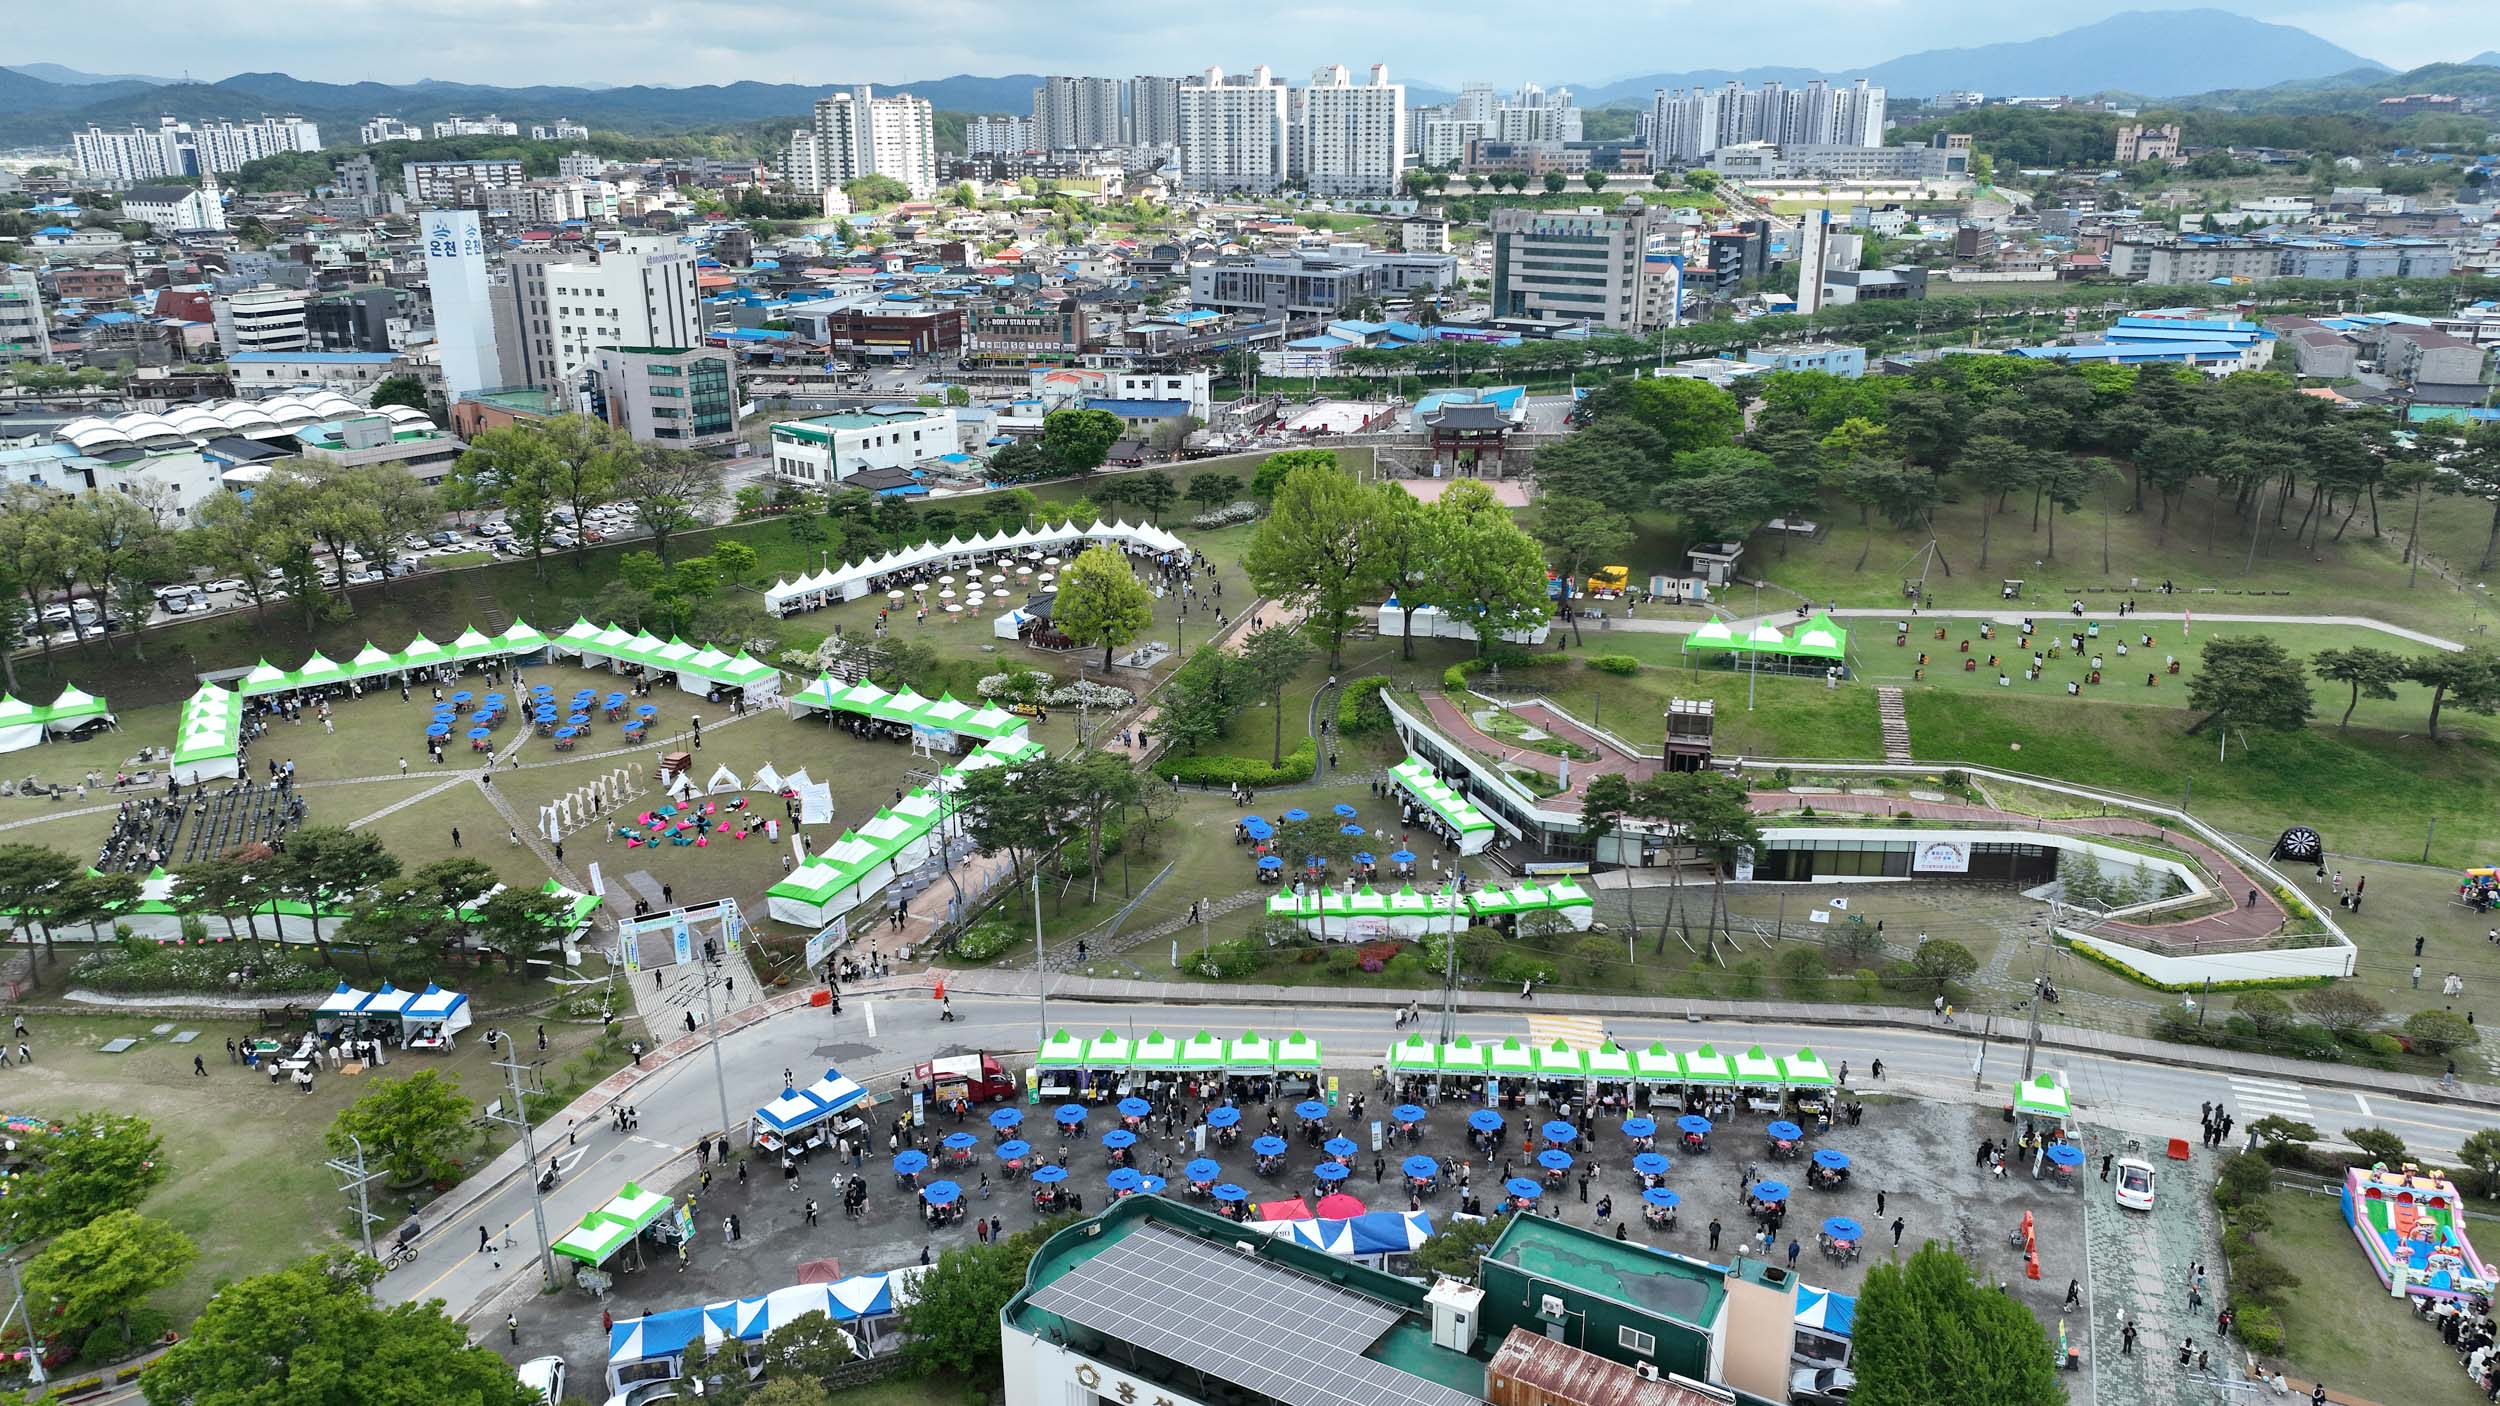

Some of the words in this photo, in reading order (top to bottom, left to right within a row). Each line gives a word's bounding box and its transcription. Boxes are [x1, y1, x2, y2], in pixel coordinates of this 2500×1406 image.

[430, 240, 457, 257] 온천
[465, 240, 482, 256] 온천
[992, 318, 1008, 326] BODY
[1009, 318, 1025, 326] STAR
[1026, 318, 1041, 326] GYM
